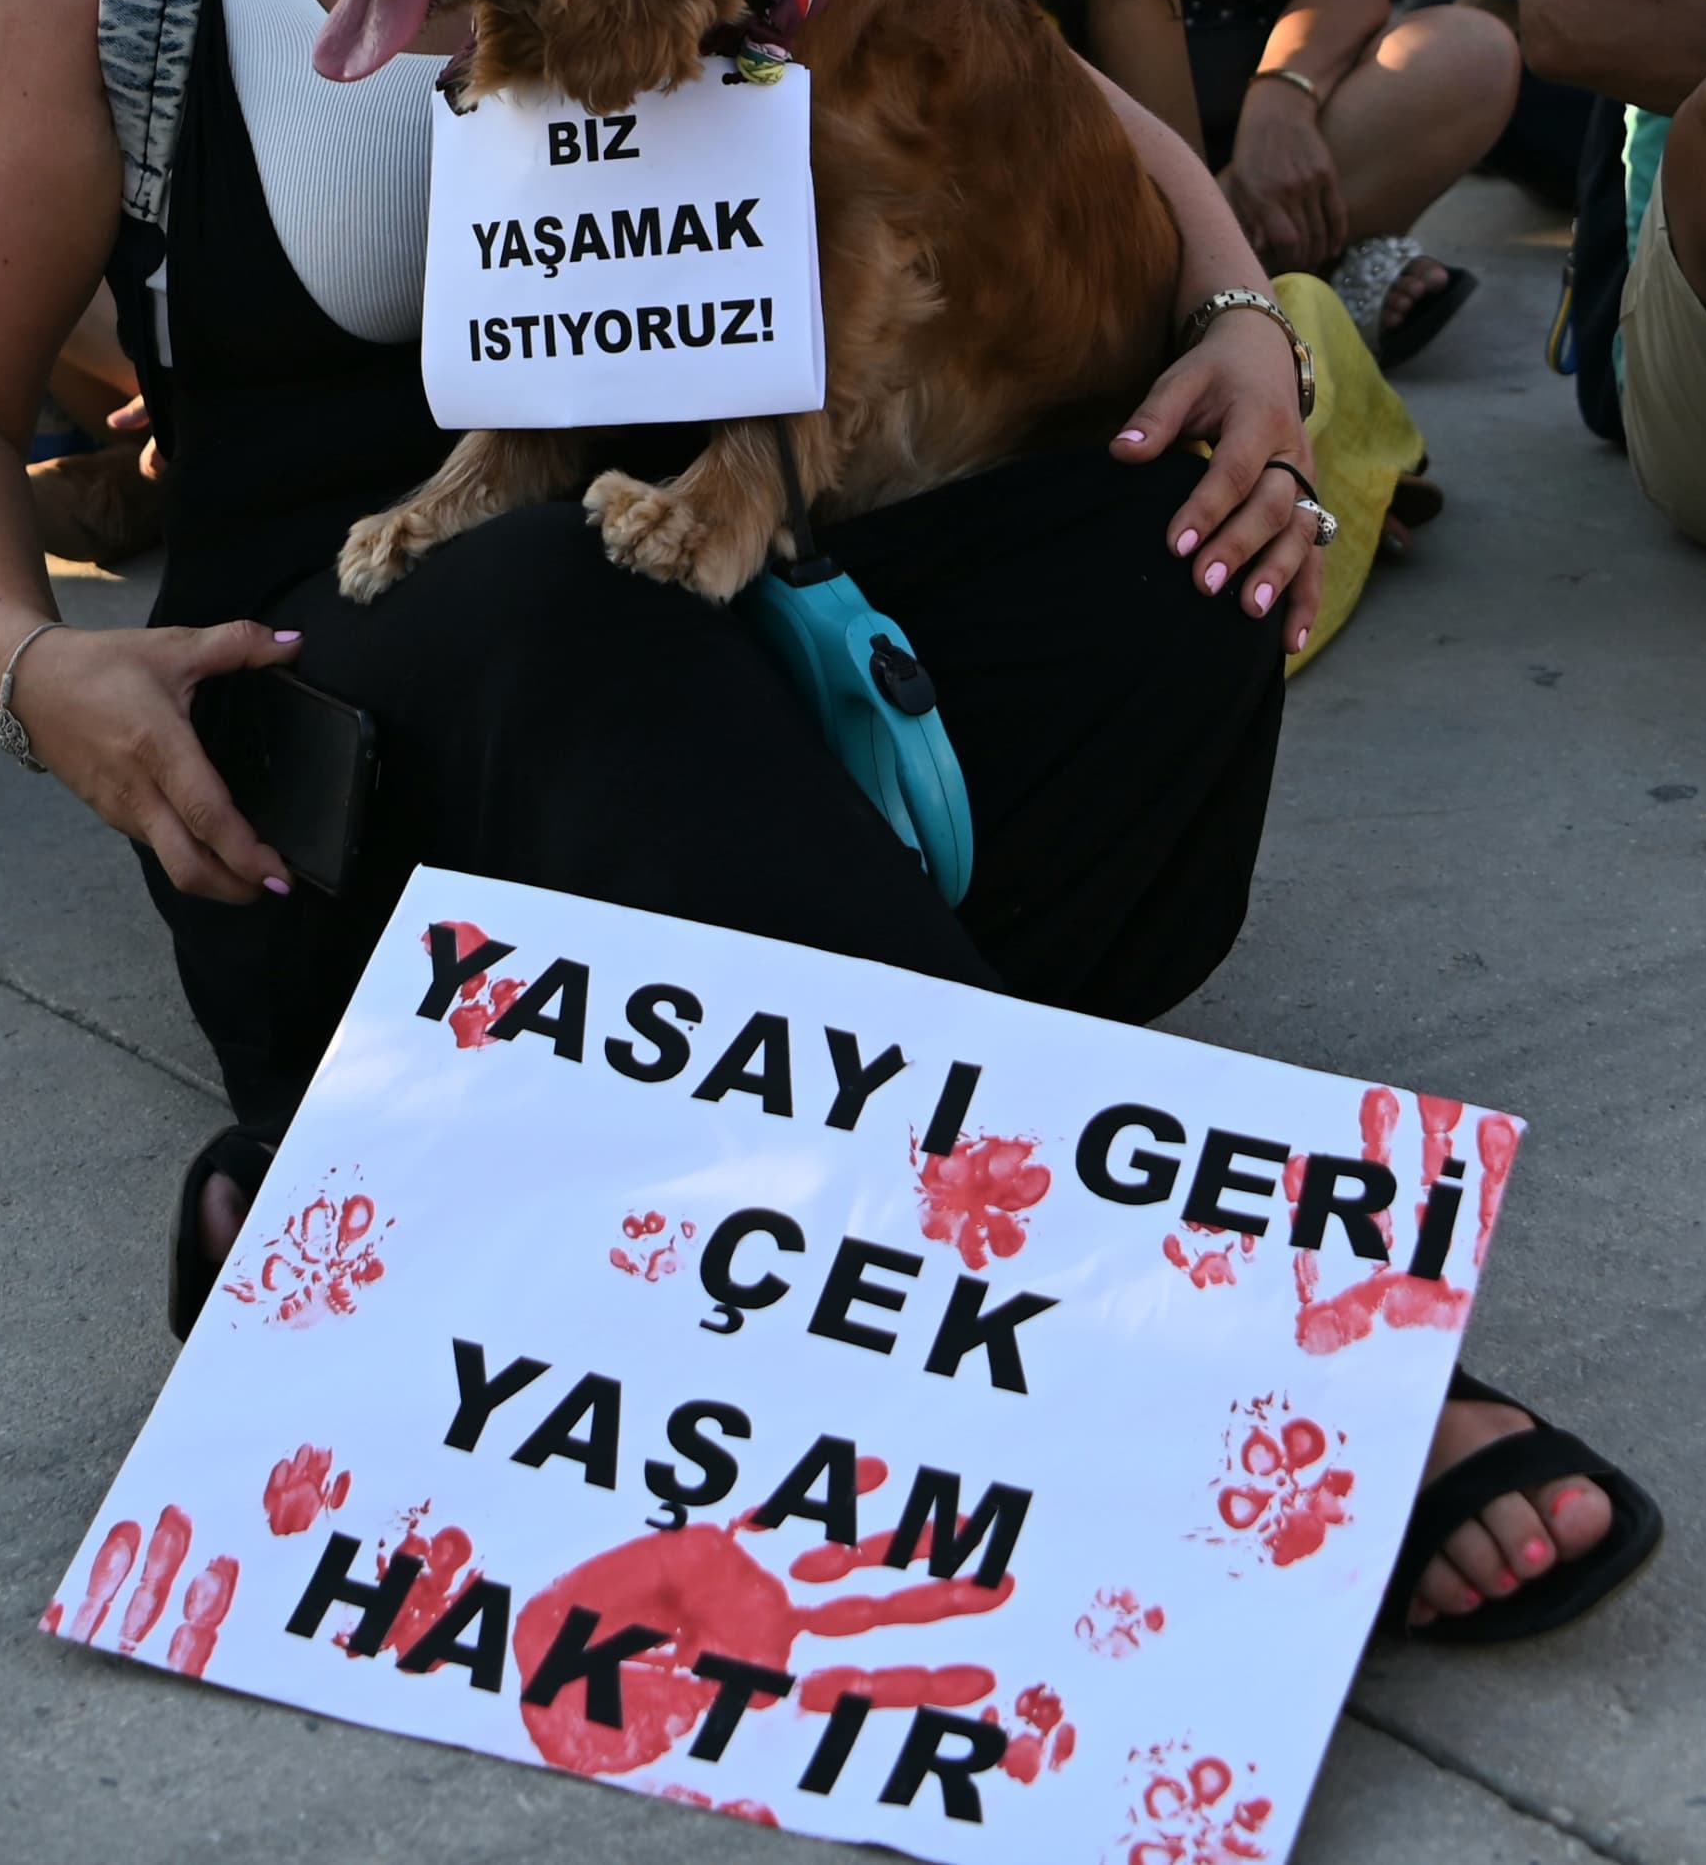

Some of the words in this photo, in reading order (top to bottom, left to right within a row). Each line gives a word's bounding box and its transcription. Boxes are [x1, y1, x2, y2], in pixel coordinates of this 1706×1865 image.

[468, 296, 775, 363] ISTIYORUZ!
[471, 196, 765, 280] YAŞAMAK
[411, 922, 985, 1159] YASAYI
[695, 1206, 1060, 1397] ÇEK
[443, 1337, 1034, 1589] YAŞAM
[284, 1532, 1009, 1824] HAKTIR
